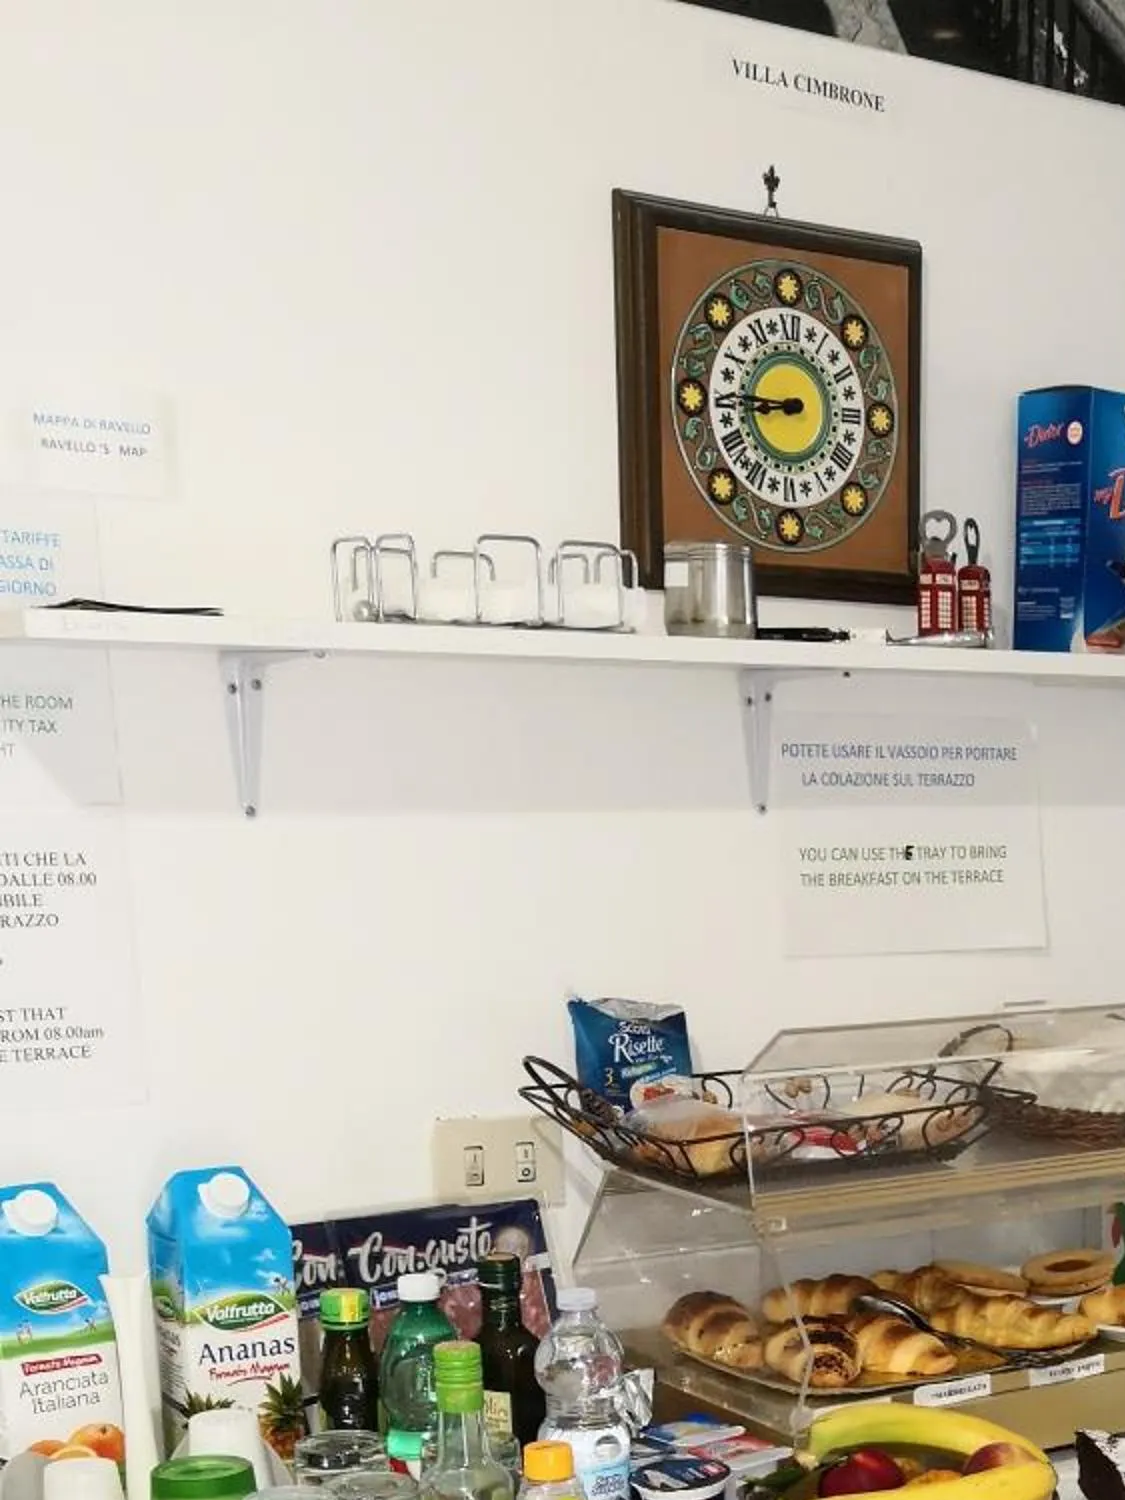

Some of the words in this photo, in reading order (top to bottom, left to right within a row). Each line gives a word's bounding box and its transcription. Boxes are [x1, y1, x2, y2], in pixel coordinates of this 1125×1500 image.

[732, 59, 788, 88] VILLA
[793, 73, 885, 112] CIMBRONE
[778, 313, 801, 342] XII
[33, 412, 79, 428] MAPPA
[83, 418, 97, 430] DI
[98, 420, 151, 436] RAVELLO
[41, 438, 96, 454] RAVELLO
[119, 445, 149, 457] MAP
[1, 528, 61, 548] TARIFFE
[0, 694, 21, 710] HE
[25, 694, 73, 711] ROOM
[28, 719, 58, 735] TAX
[781, 743, 829, 759] POTETE
[832, 743, 872, 759] USARE
[875, 745, 886, 759] IL
[887, 744, 939, 760] VASSOIO
[941, 746, 963, 760] PER
[965, 747, 1018, 761] PORTARE
[801, 771, 818, 787] LA
[820, 771, 890, 787] COLAZIONE
[892, 773, 914, 787] SUL
[917, 772, 975, 788] TERRAZZO
[24, 851, 59, 867] CHE
[64, 852, 87, 867] LA
[799, 846, 827, 861] YOU
[831, 846, 859, 861] CAN
[861, 846, 886, 861] USE
[888, 845, 915, 861] THE
[917, 846, 947, 860] TRAY
[950, 845, 967, 859] TO
[969, 844, 1007, 860] BRING
[57, 872, 97, 887] 08.00
[799, 872, 825, 887] THE
[828, 870, 899, 887] BREAKFAST
[902, 870, 920, 886] ON
[923, 870, 948, 885] THE
[951, 868, 1004, 885] TERRACE
[20, 1006, 67, 1022] THAT
[12, 1045, 92, 1062] TERRACE
[199, 1337, 296, 1365] Ananas
[20, 1371, 109, 1398] Aranciata
[32, 1391, 101, 1415] Italiana
